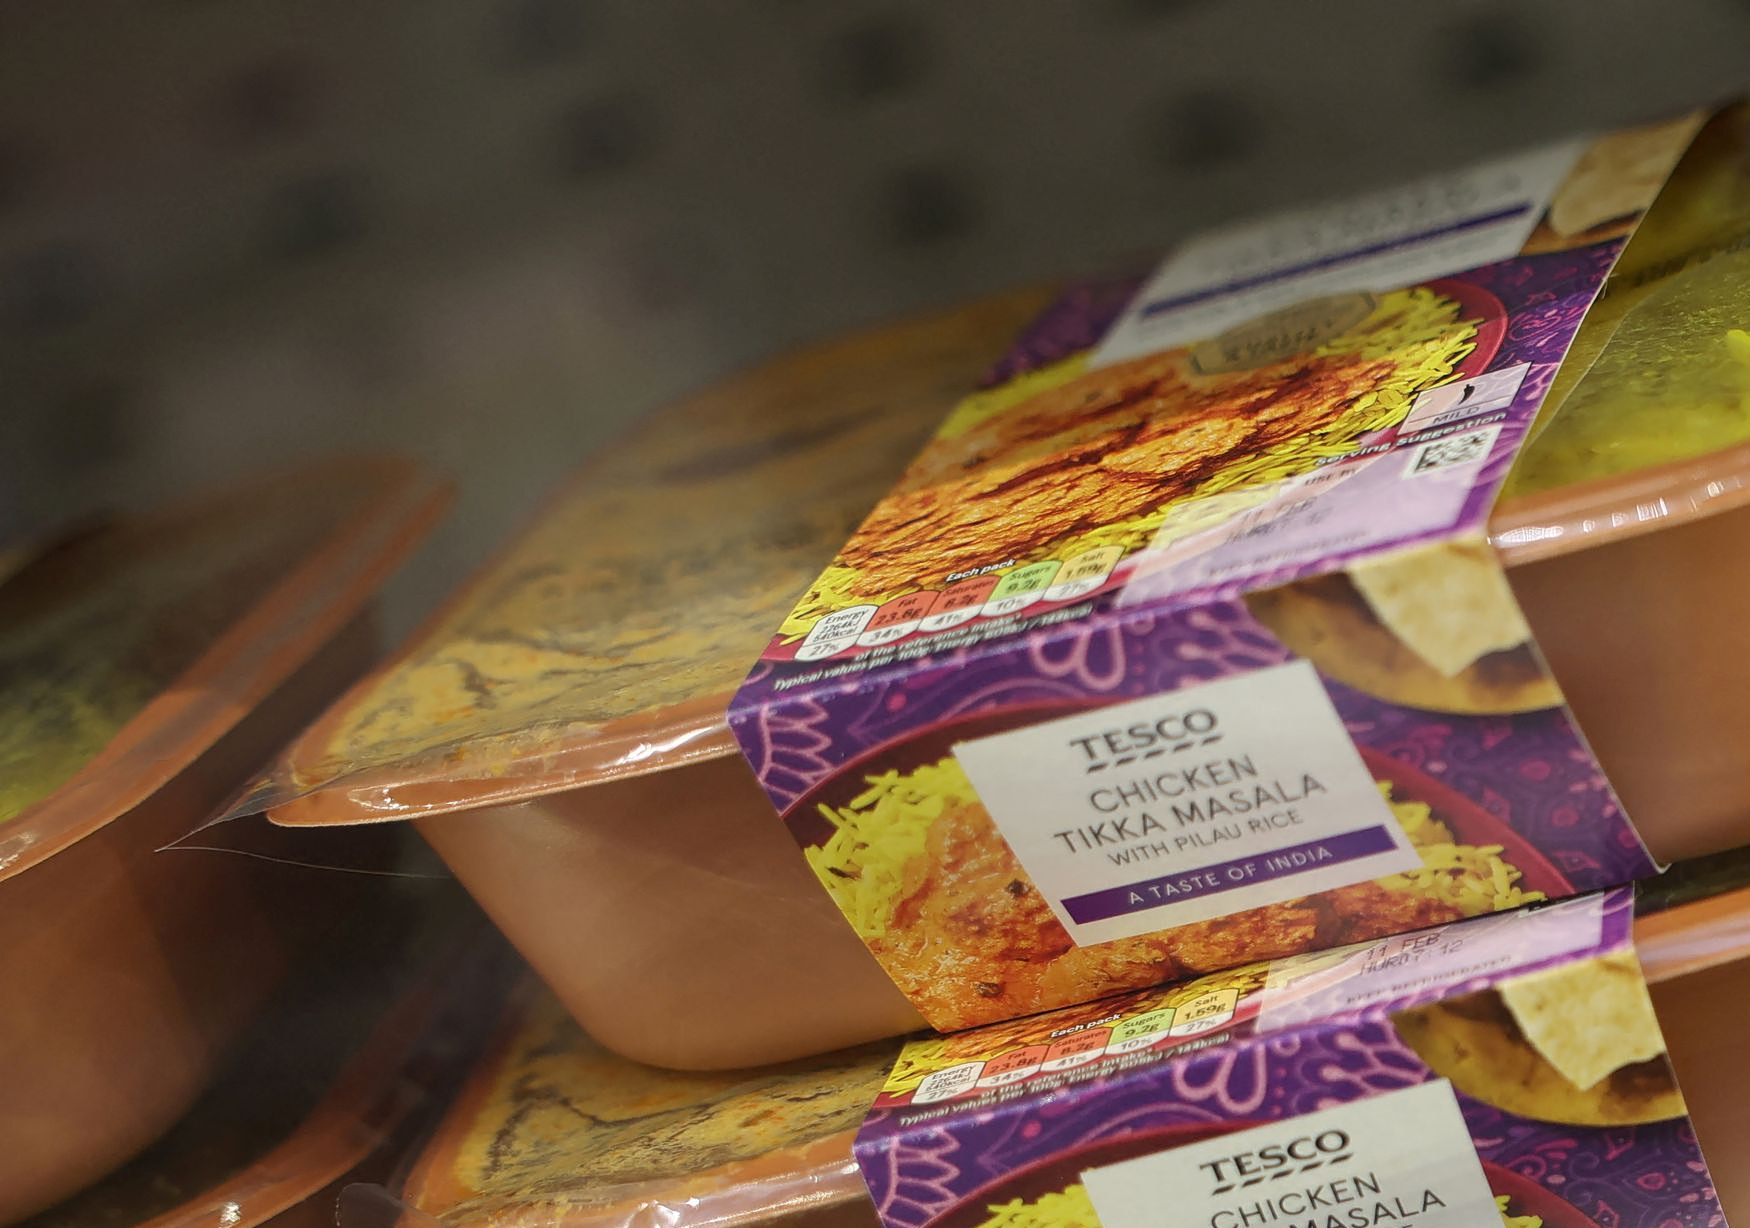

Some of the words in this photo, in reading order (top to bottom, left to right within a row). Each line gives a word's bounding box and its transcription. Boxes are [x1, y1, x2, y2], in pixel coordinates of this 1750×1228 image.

[1432, 406, 1481, 426] MILD
[1395, 411, 1507, 448] suggestion
[946, 564, 984, 583] Each
[981, 558, 1016, 577] pack
[825, 608, 869, 625] Energy
[774, 668, 824, 693] Typical
[824, 659, 868, 680] values
[1069, 708, 1218, 762] TESCO
[1089, 754, 1259, 813] CHICKEN
[1054, 812, 1166, 854] TIKKA
[1171, 773, 1328, 828] MASALA
[1108, 842, 1170, 867] WITH
[1177, 825, 1243, 853] PILAU
[1250, 808, 1305, 834] RICE
[1128, 891, 1145, 905] A
[1148, 872, 1222, 899] TASTE
[1228, 862, 1258, 882] OF
[1266, 846, 1334, 873] INDIA
[1401, 932, 1441, 952] FEB
[1183, 1000, 1227, 1021] 1.59g
[1195, 993, 1219, 1007] Salt
[1050, 1026, 1087, 1040] Each
[1086, 1013, 1121, 1031] pack
[1122, 1011, 1166, 1030] Sugars
[1007, 1051, 1026, 1060] Fat
[931, 1064, 977, 1081] Energy
[900, 1105, 950, 1128] Typical
[1199, 1129, 1350, 1184] TESCO
